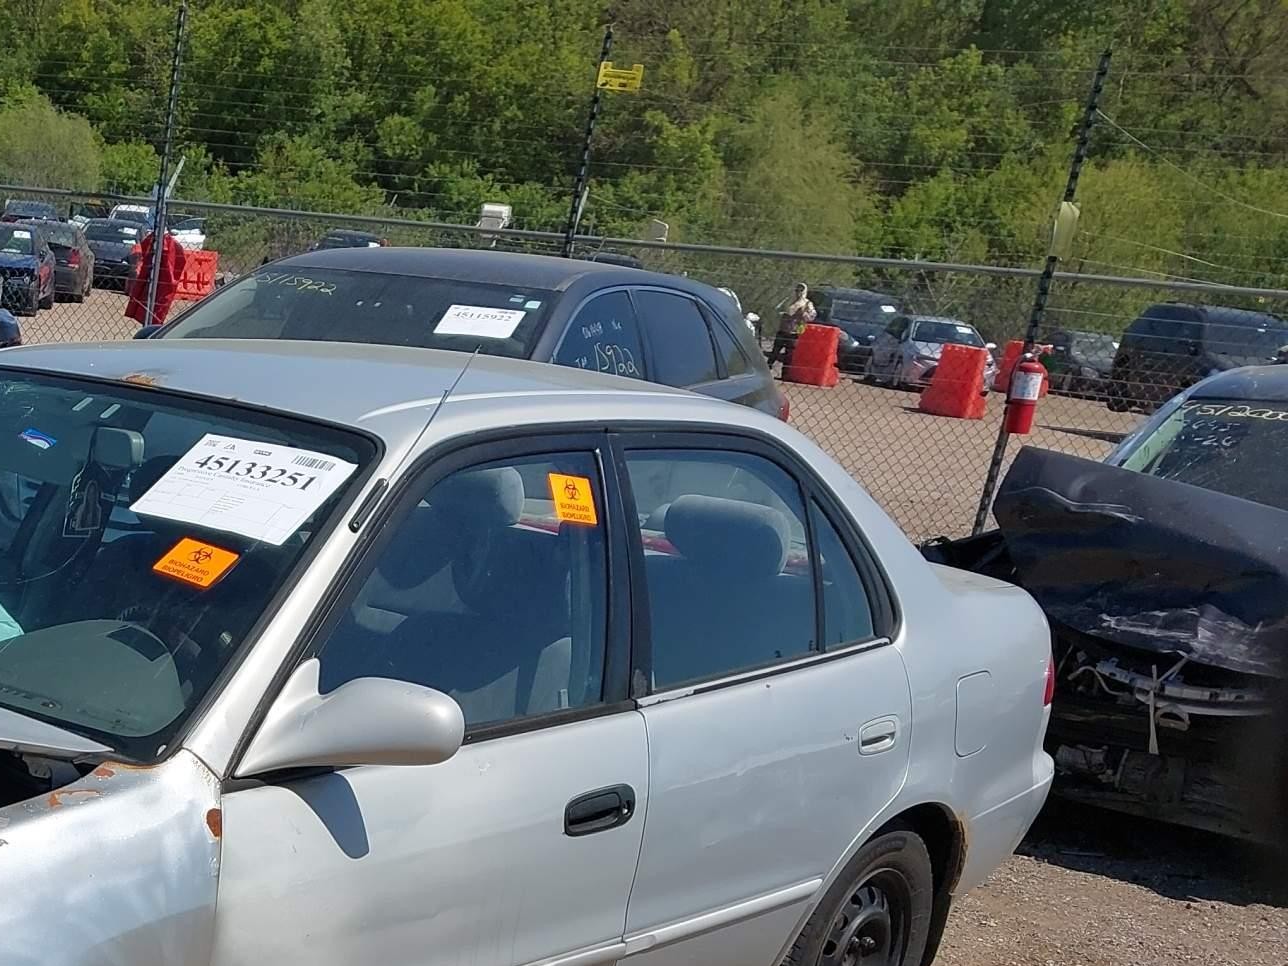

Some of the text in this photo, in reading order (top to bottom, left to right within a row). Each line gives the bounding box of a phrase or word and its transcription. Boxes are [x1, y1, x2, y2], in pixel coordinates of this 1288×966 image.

[194, 454, 318, 492] 45133251
[161, 564, 204, 583] BIOPELIGRO
[168, 559, 210, 577] BIOHAZARD
